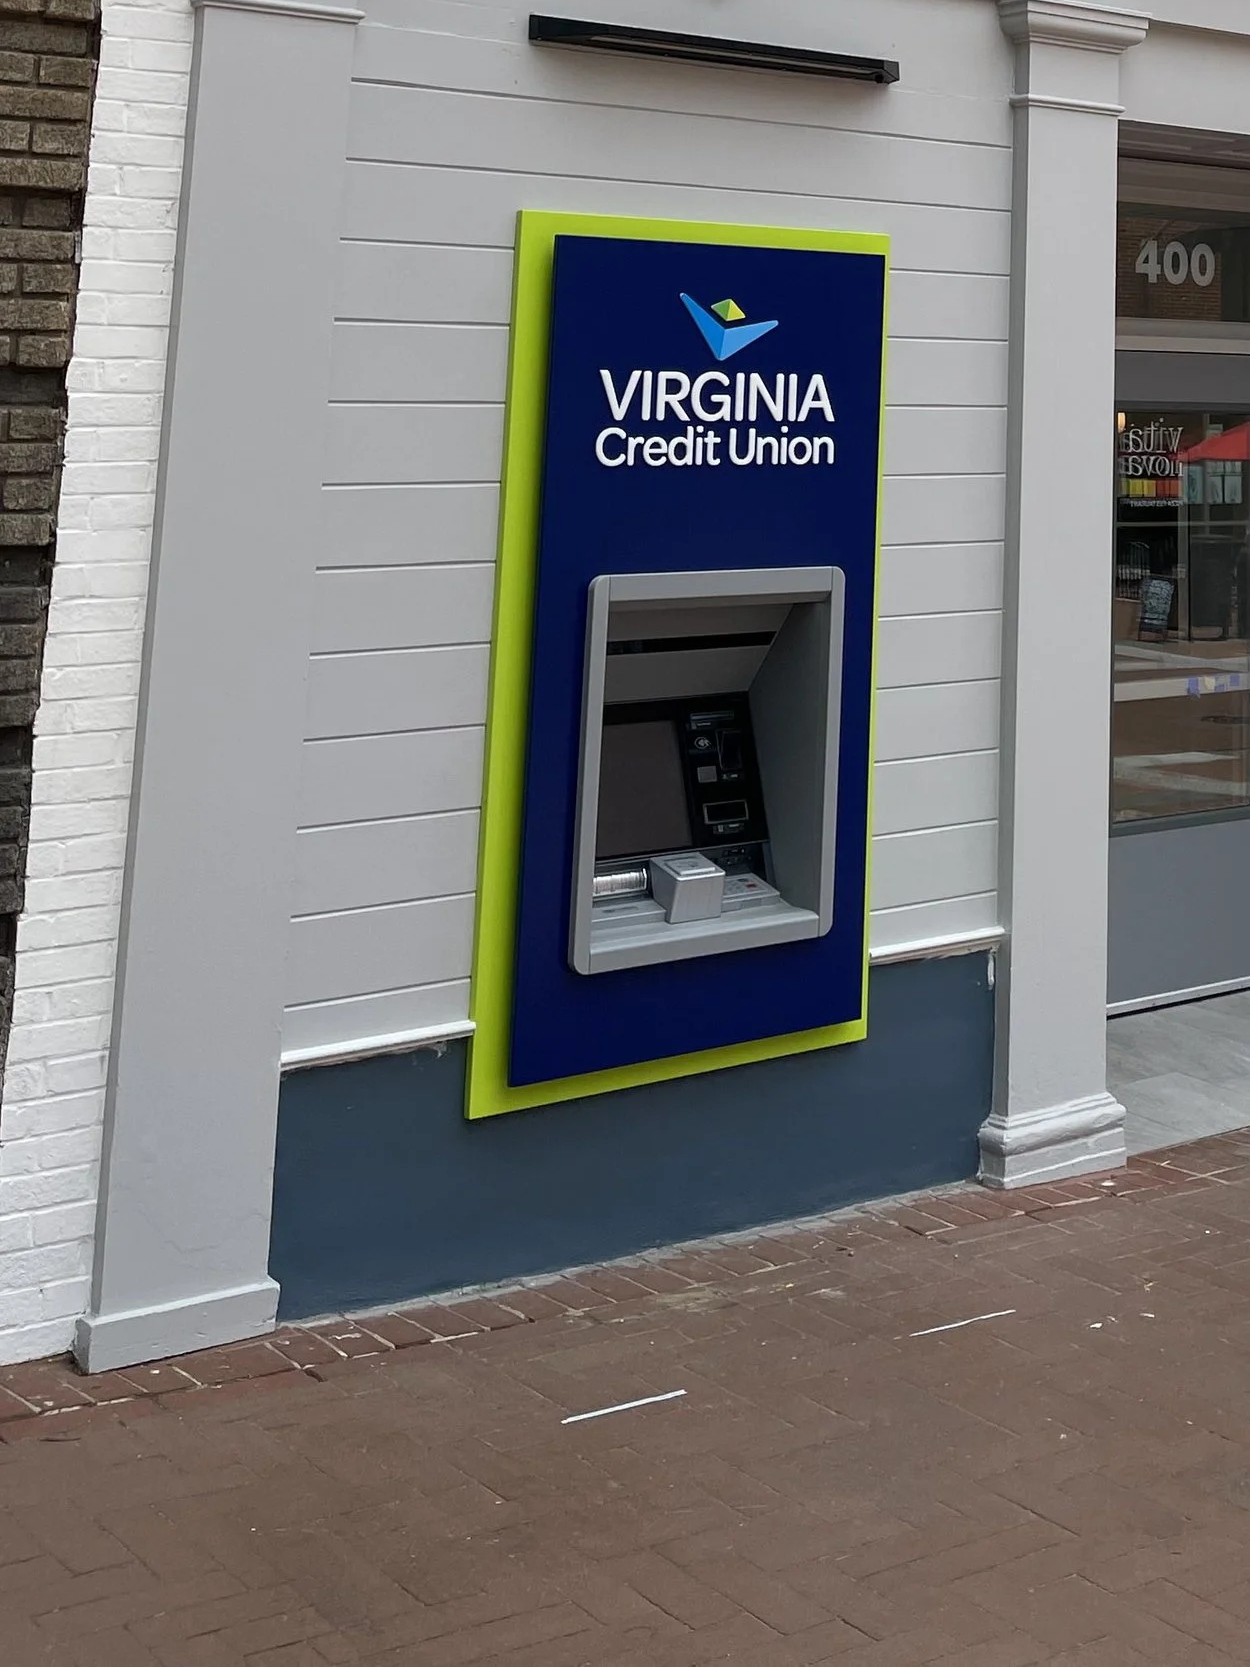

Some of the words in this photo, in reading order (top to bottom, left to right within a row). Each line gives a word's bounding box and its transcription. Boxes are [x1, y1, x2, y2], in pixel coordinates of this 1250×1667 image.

[1135, 239, 1216, 287] 400
[599, 369, 836, 423] VIRGINIA
[595, 426, 721, 467] Credit
[728, 426, 835, 466] Union
